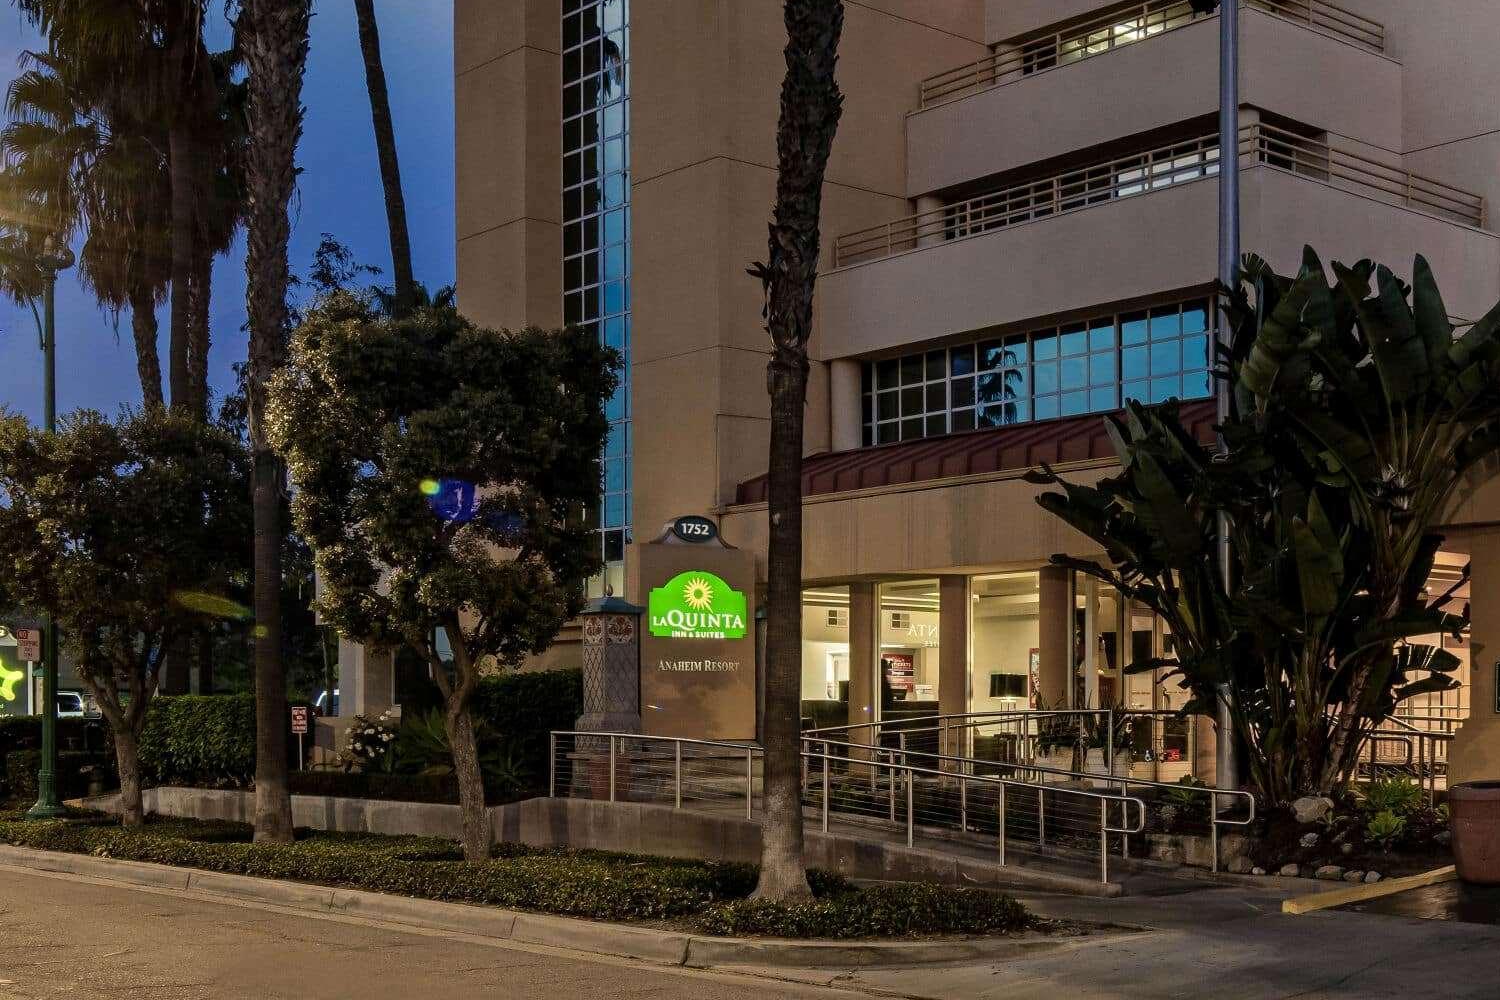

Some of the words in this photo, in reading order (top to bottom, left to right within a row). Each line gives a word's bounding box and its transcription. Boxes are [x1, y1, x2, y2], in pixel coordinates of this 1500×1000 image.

[681, 523, 710, 536] 1752
[653, 616, 668, 627] LA
[667, 609, 745, 631] QUINTA
[671, 630, 687, 638] INN
[695, 631, 725, 639] SUITES
[659, 659, 702, 672] ANAHEIM
[704, 660, 740, 672] RESORT
